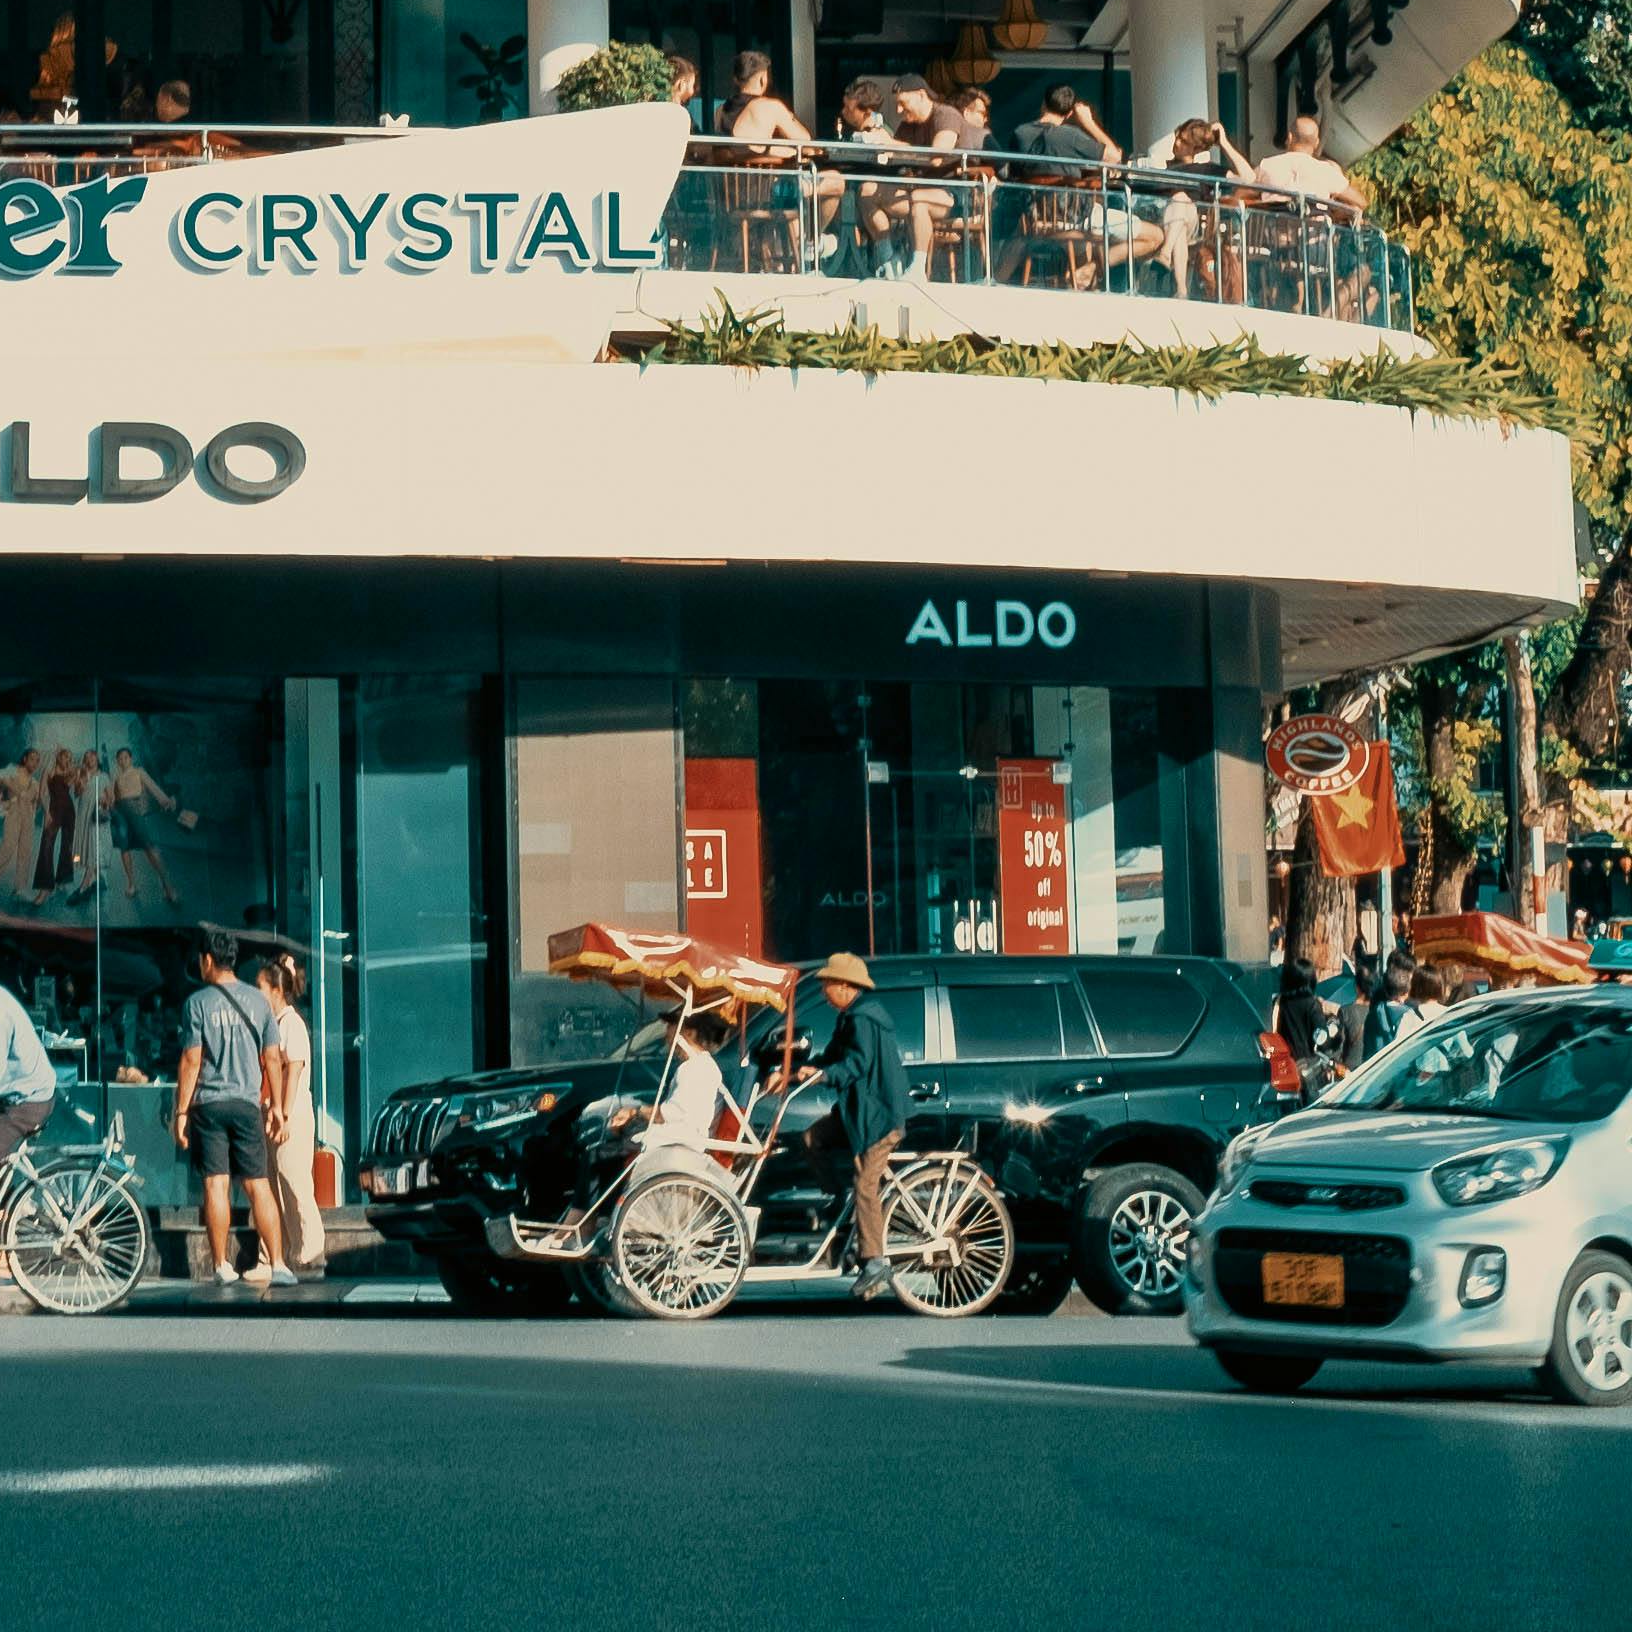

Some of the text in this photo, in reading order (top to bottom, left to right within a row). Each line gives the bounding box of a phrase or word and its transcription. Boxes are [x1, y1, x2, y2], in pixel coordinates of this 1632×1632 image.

[176, 190, 662, 269] CRYSTAL
[905, 600, 1077, 648] ALDO
[1272, 720, 1362, 750] HIGHLANDS
[1285, 770, 1353, 790] COFFEE
[1024, 830, 1062, 868] 50%
[821, 891, 887, 907] ALDO
[1037, 877, 1051, 897] off
[1027, 907, 1064, 930] original
